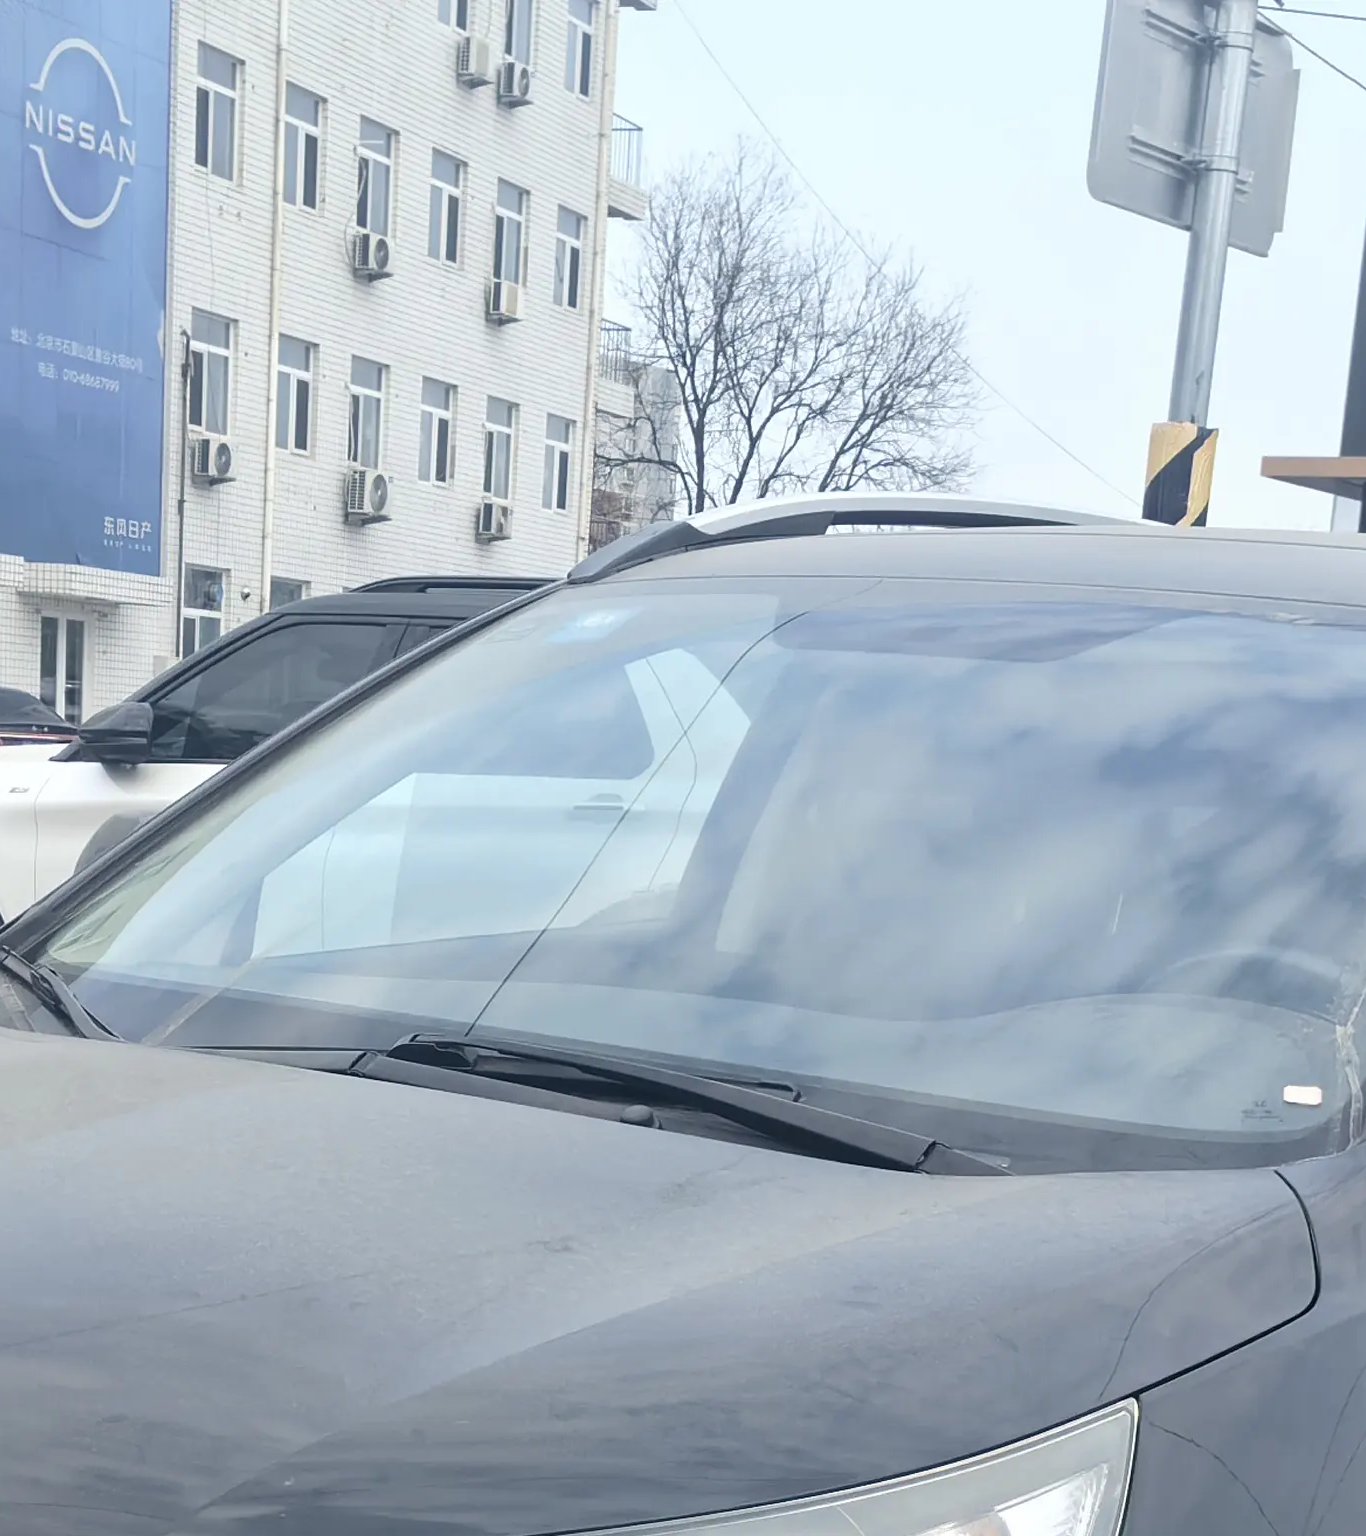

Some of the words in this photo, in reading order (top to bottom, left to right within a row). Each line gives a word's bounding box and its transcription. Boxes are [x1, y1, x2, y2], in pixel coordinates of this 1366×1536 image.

[25, 100, 136, 166] NISSAN
[104, 516, 152, 539] 东风日产
